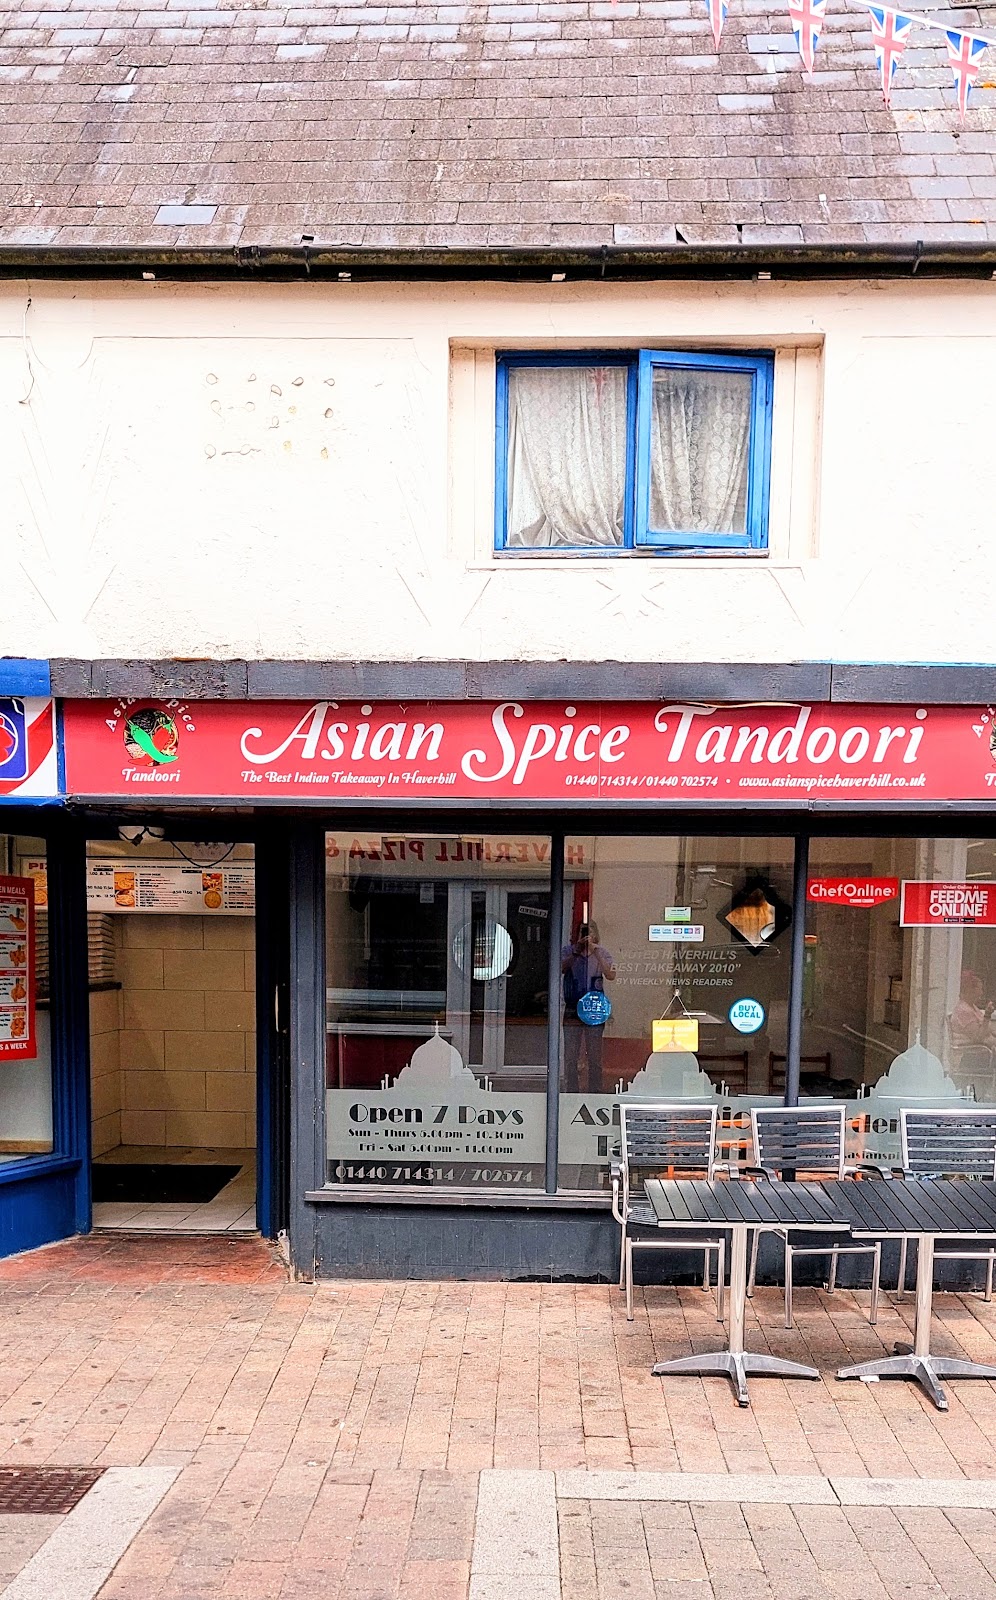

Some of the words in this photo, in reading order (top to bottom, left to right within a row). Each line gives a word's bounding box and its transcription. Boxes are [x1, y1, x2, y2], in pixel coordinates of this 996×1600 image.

[105, 698, 142, 732] Asia
[159, 698, 196, 732] pice
[240, 701, 445, 765] Asian
[461, 702, 630, 784] Spice
[655, 704, 928, 764] Tandoori
[121, 767, 181, 782] Tandoori
[241, 770, 263, 784] The
[264, 770, 292, 784] Best
[294, 771, 330, 784] Indian
[331, 771, 386, 787] Takeaway
[387, 772, 400, 784] In
[401, 771, 457, 785] Haverhill
[565, 774, 598, 787] 01440
[680, 774, 718, 787] 702574
[738, 774, 926, 789] www.asianspicehaverhill.co.uk
[6, 886, 26, 895] MEALS
[809, 884, 892, 897] ChefOnline
[930, 890, 989, 904] FEEDME
[929, 903, 983, 917] ONLINE
[610, 963, 639, 973] BEST
[643, 963, 706, 973] TAKEAWAY
[616, 978, 627, 986] BY
[629, 978, 664, 986] WEEKLY
[665, 979, 691, 987] NEWS
[692, 979, 733, 987] READERS
[738, 1004, 757, 1012] BUY
[733, 1011, 761, 1019] LOCAL
[12, 1042, 27, 1050] WEEK
[349, 1103, 423, 1124] Open
[431, 1105, 449, 1124] 7
[458, 1105, 524, 1126] Days
[348, 1128, 371, 1137] Sun
[384, 1128, 417, 1138] Thurs
[359, 1143, 376, 1152] Fri
[388, 1143, 406, 1152] Sat
[336, 1165, 387, 1181] 01440
[392, 1166, 455, 1182] 714314
[471, 1168, 533, 1184] 702574
